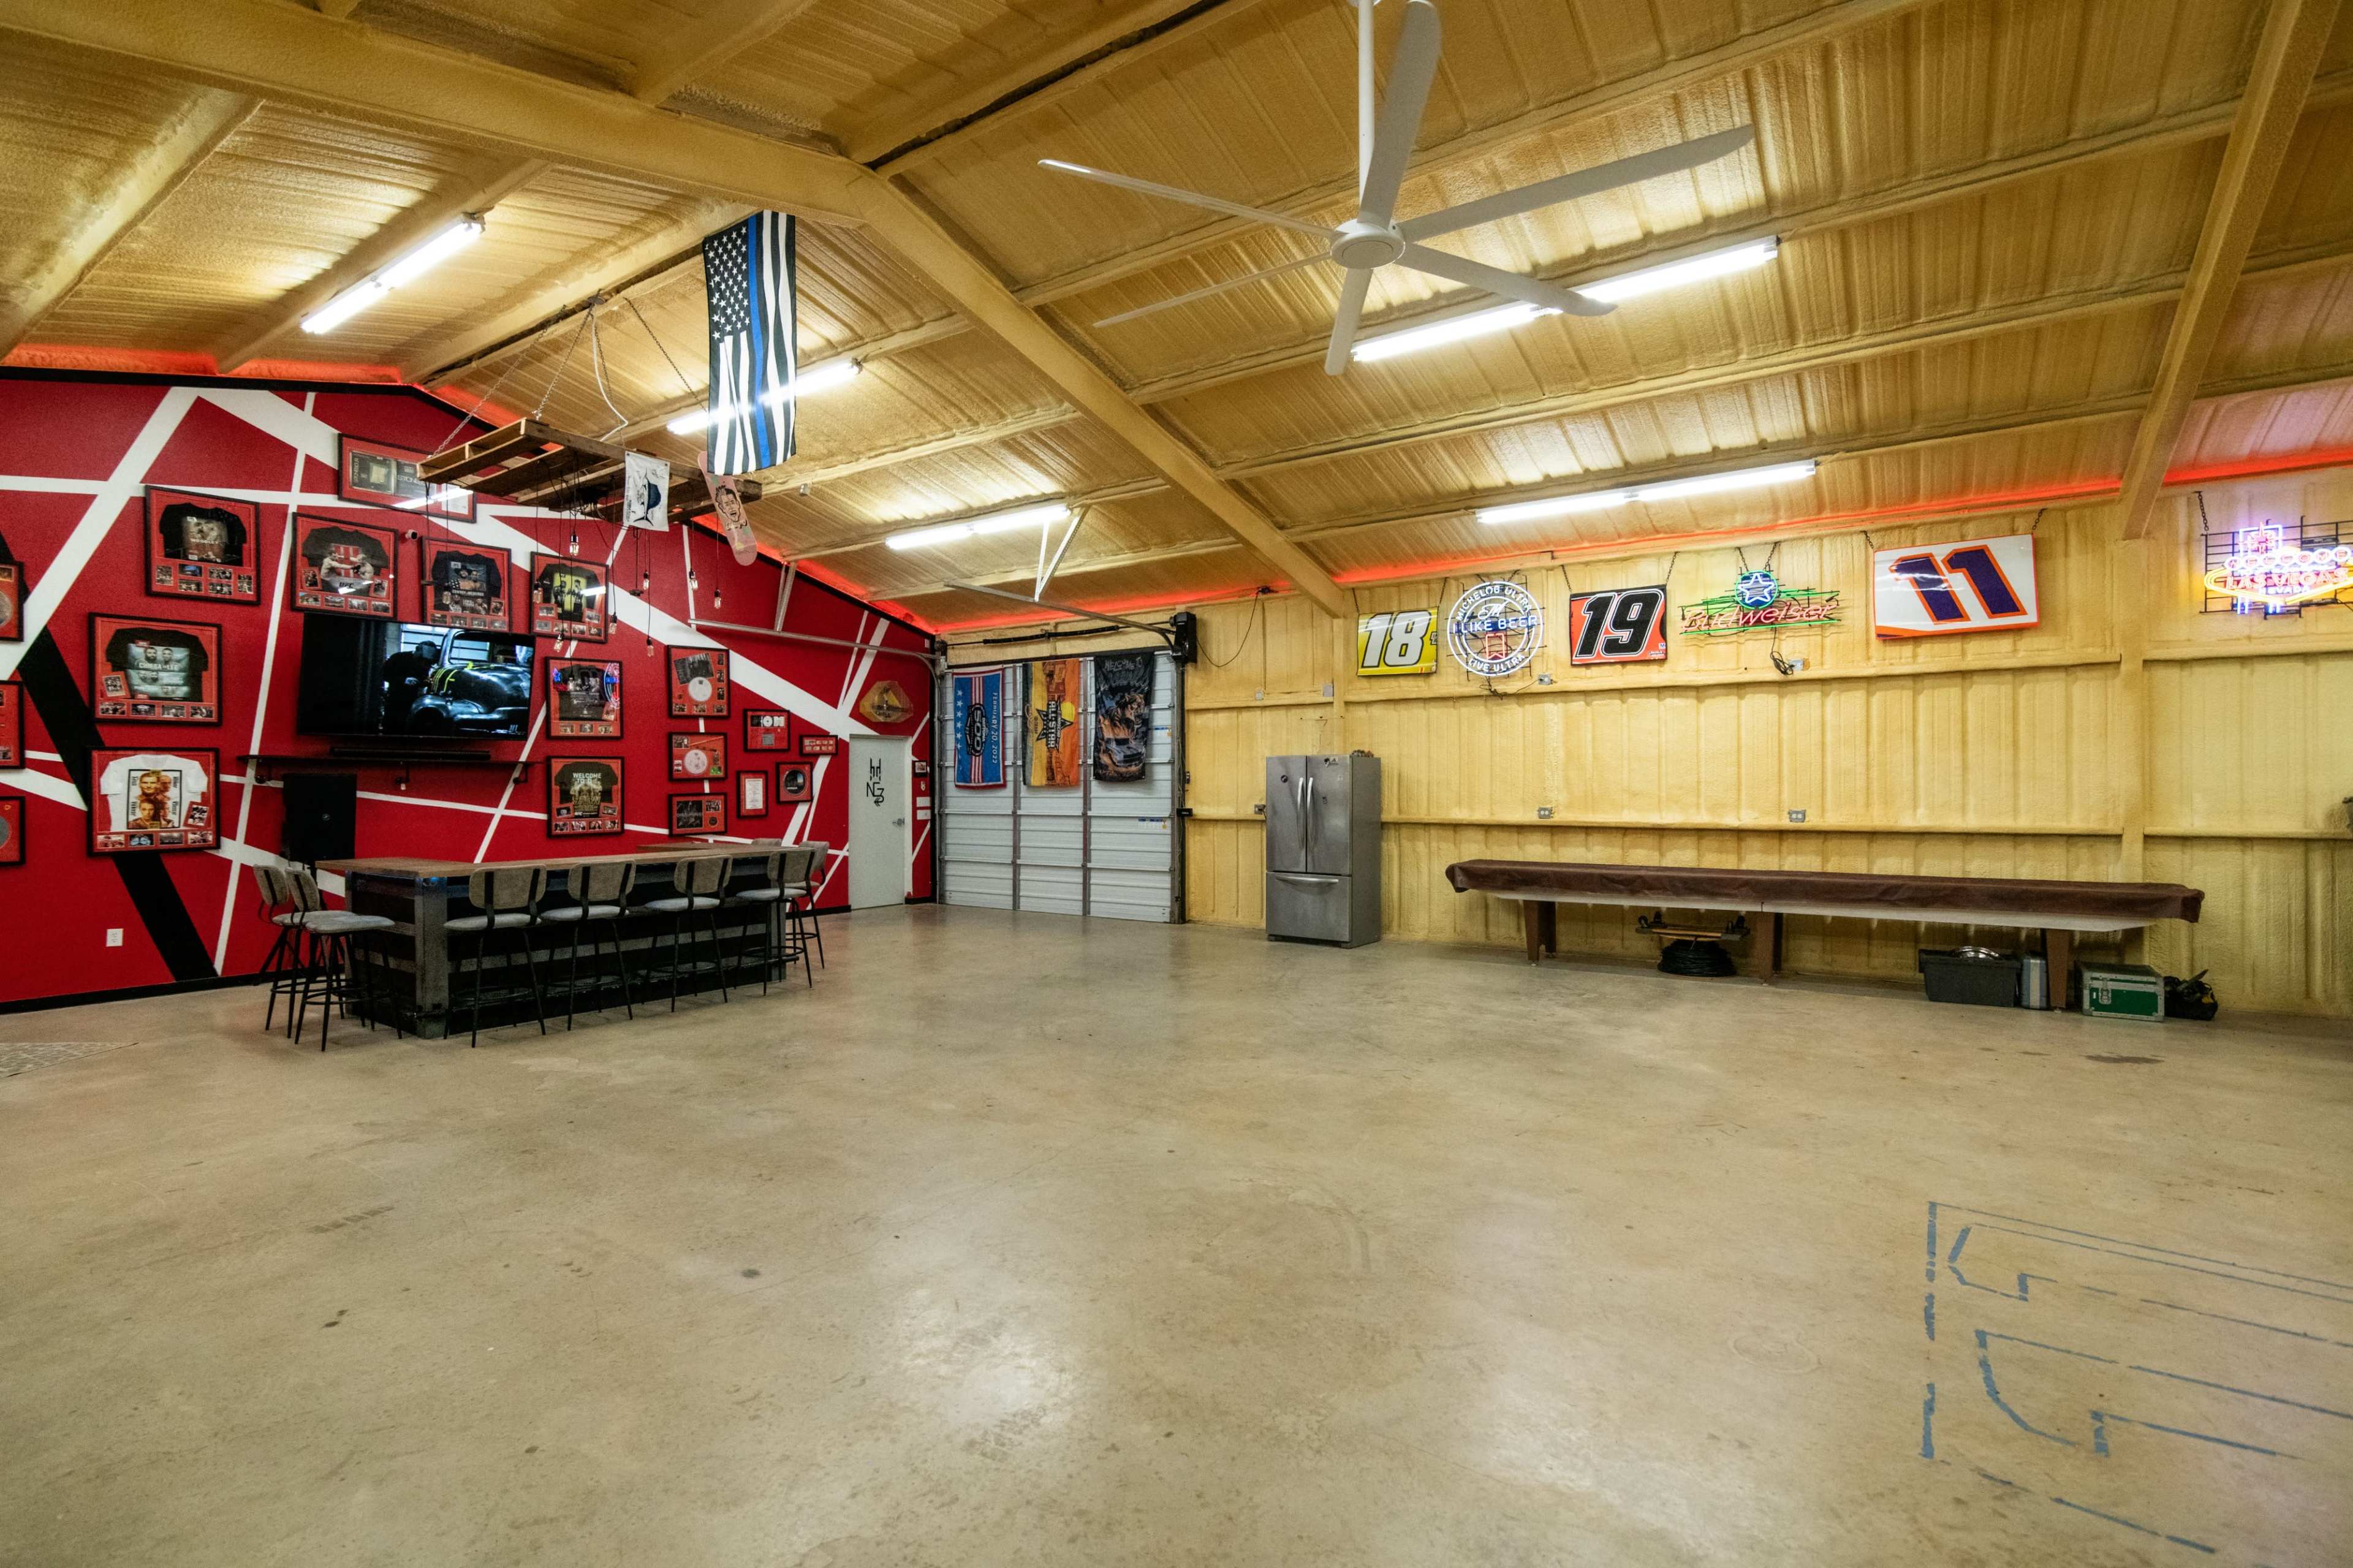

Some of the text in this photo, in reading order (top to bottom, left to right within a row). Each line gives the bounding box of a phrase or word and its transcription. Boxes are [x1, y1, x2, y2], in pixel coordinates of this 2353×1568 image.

[2226, 548, 2350, 569] WELCOME
[1888, 544, 2028, 625] 11
[2226, 573, 2266, 589] LAS
[2271, 568, 2349, 587] VEGAS
[1456, 585, 1533, 621] MICHELOB ULTRA
[1682, 602, 1837, 631] Budweiser
[1461, 619, 1493, 634] LIKE
[1498, 615, 1538, 629] BEER
[1572, 588, 1664, 659] 19
[1361, 610, 1431, 668] 18
[1469, 654, 1525, 672] LIVE ULTRA
